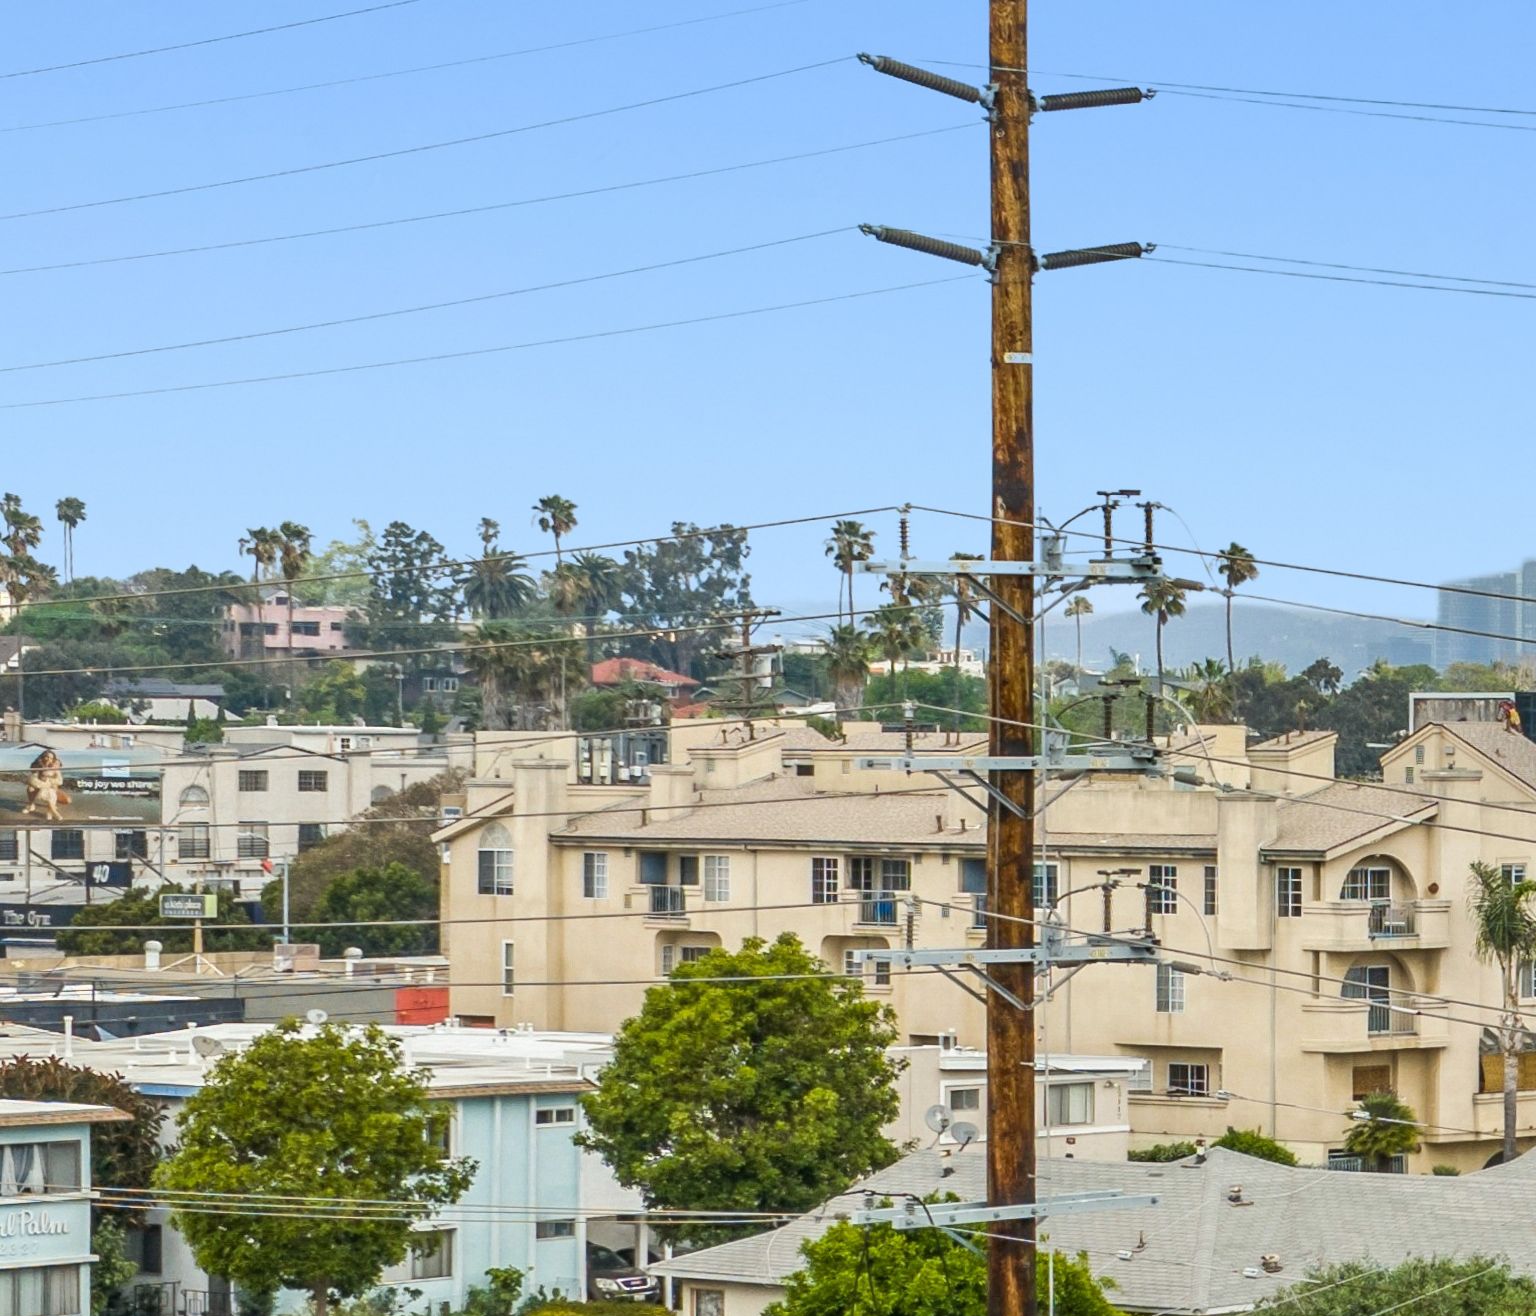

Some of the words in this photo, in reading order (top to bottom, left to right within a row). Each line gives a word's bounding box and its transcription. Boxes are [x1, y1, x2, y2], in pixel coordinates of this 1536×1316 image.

[77, 779, 93, 789] the
[95, 779, 109, 791] joy
[111, 781, 124, 790] we
[3, 910, 25, 925] The
[19, 1209, 70, 1237] Palm
